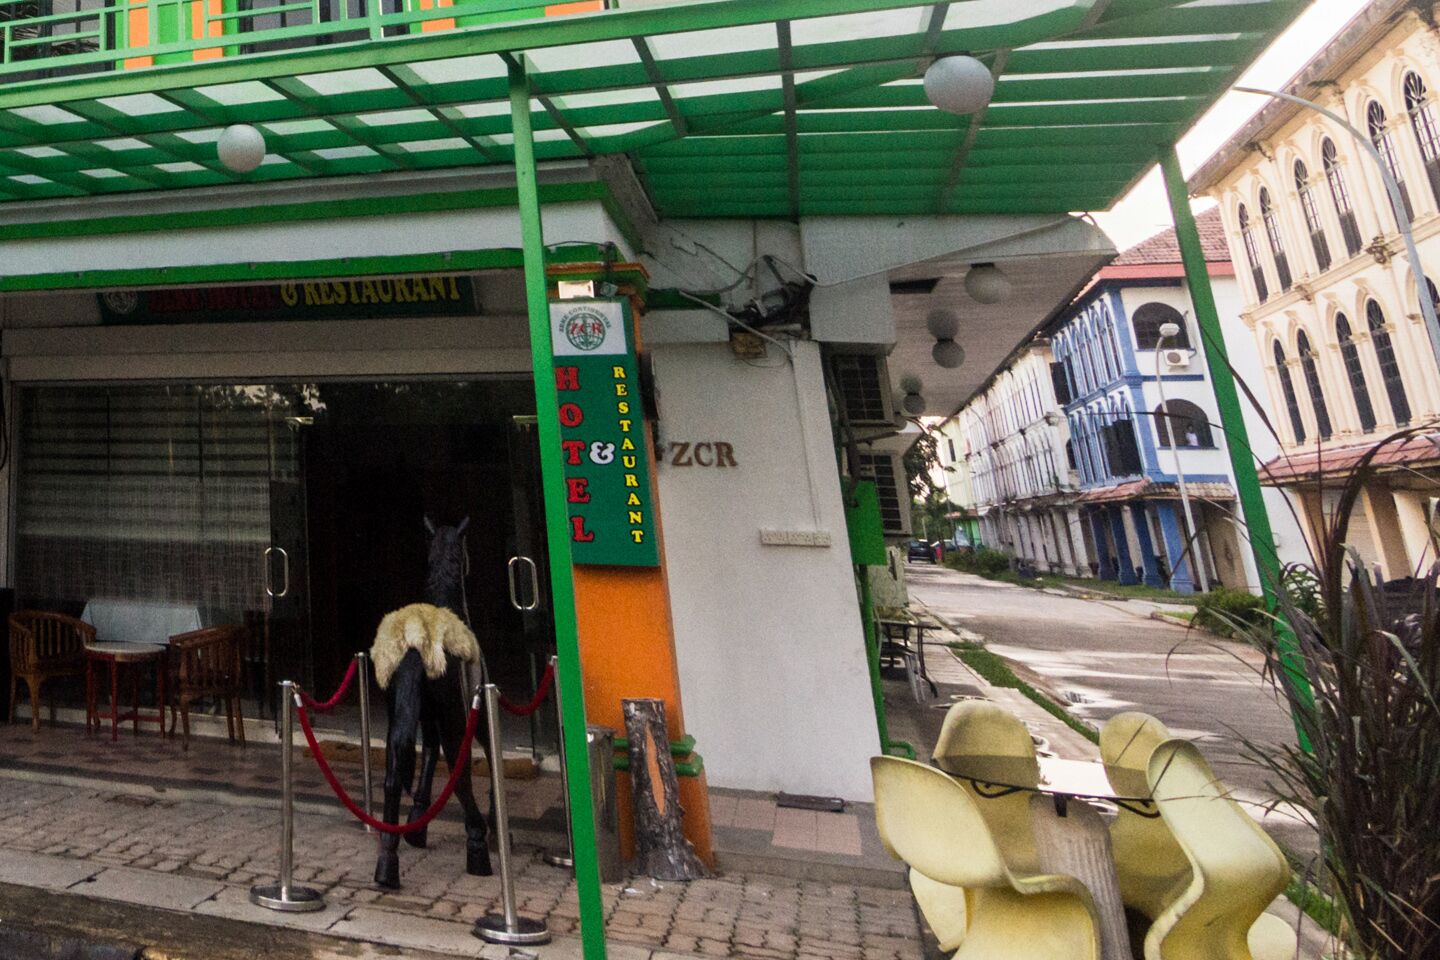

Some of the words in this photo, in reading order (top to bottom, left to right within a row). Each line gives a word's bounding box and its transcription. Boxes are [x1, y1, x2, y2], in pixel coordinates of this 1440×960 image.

[304, 275, 461, 306] RESTAURANT
[555, 366, 595, 543] HOTEL
[589, 441, 616, 465] &
[613, 365, 644, 543] RESTAURANT
[669, 441, 739, 468] ZCR
